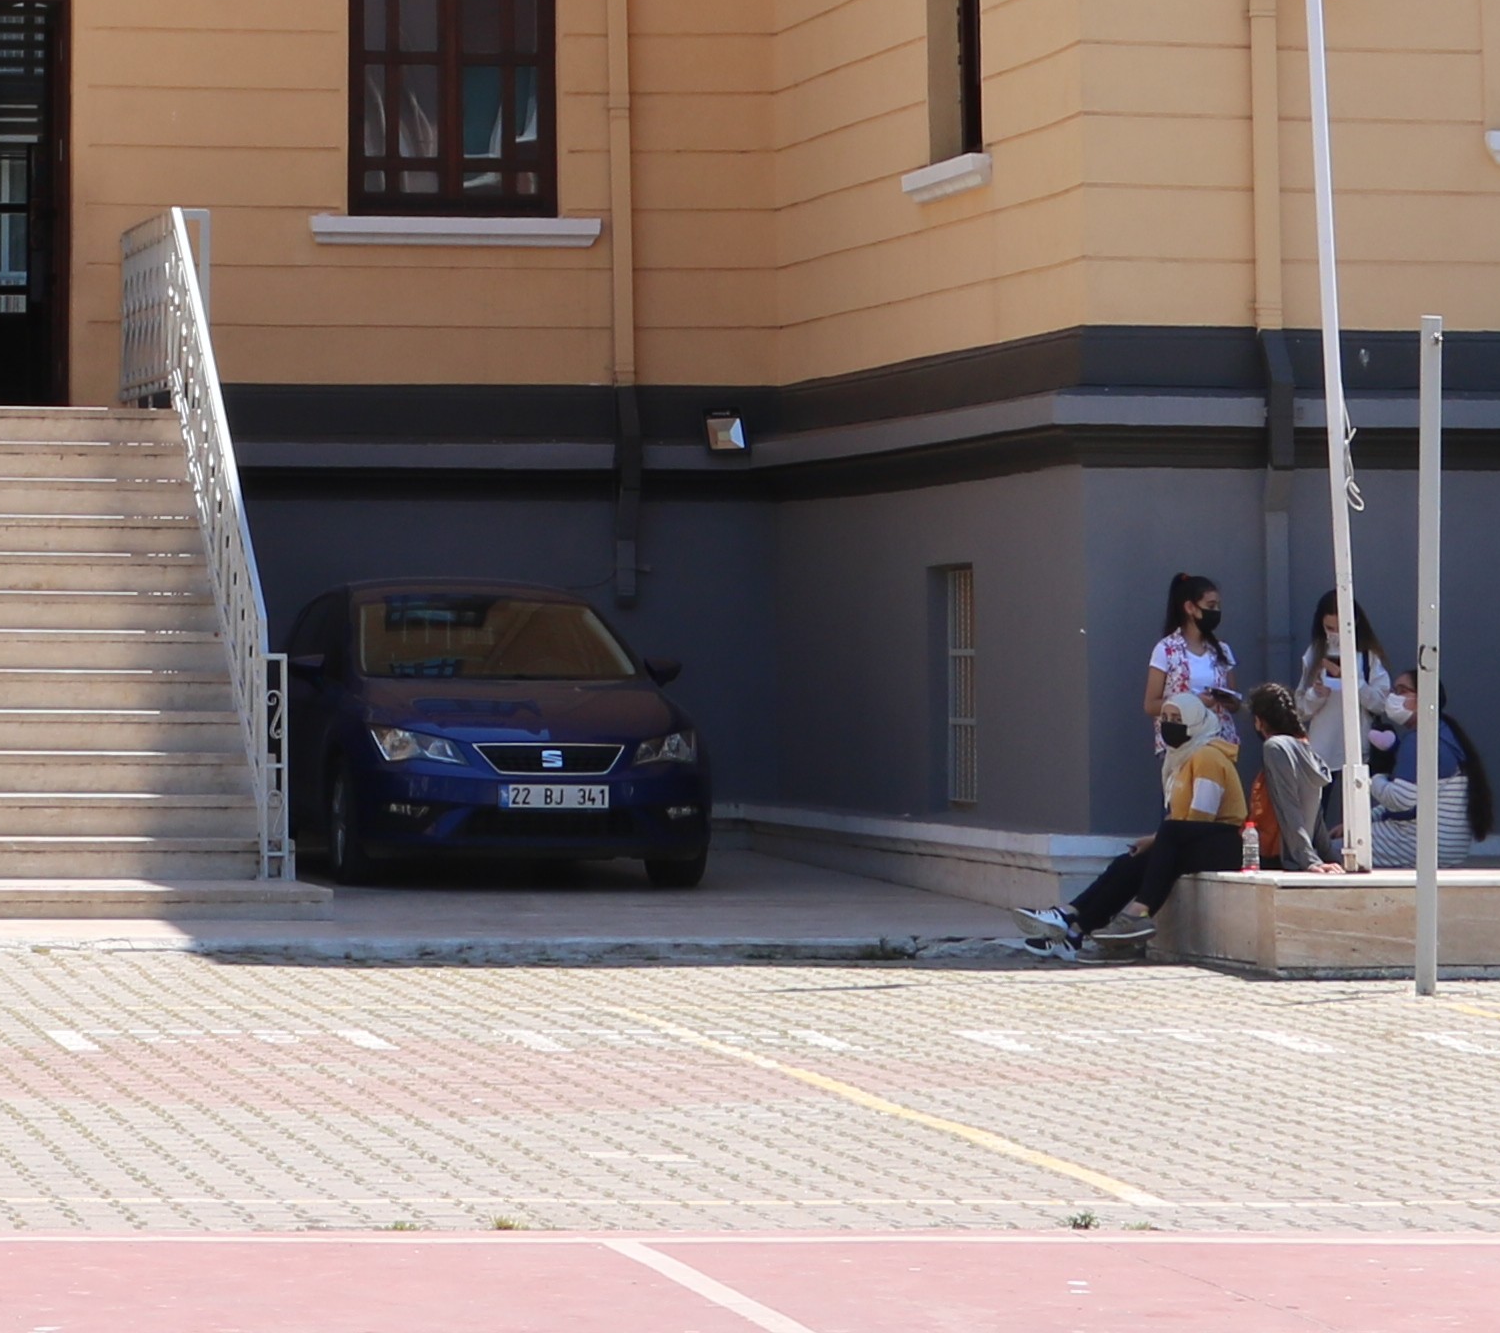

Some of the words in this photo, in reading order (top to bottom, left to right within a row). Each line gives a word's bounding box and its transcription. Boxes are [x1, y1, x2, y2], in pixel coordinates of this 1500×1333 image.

[511, 788, 531, 805] 22
[544, 789, 564, 805] BJ
[577, 789, 605, 806] 341
